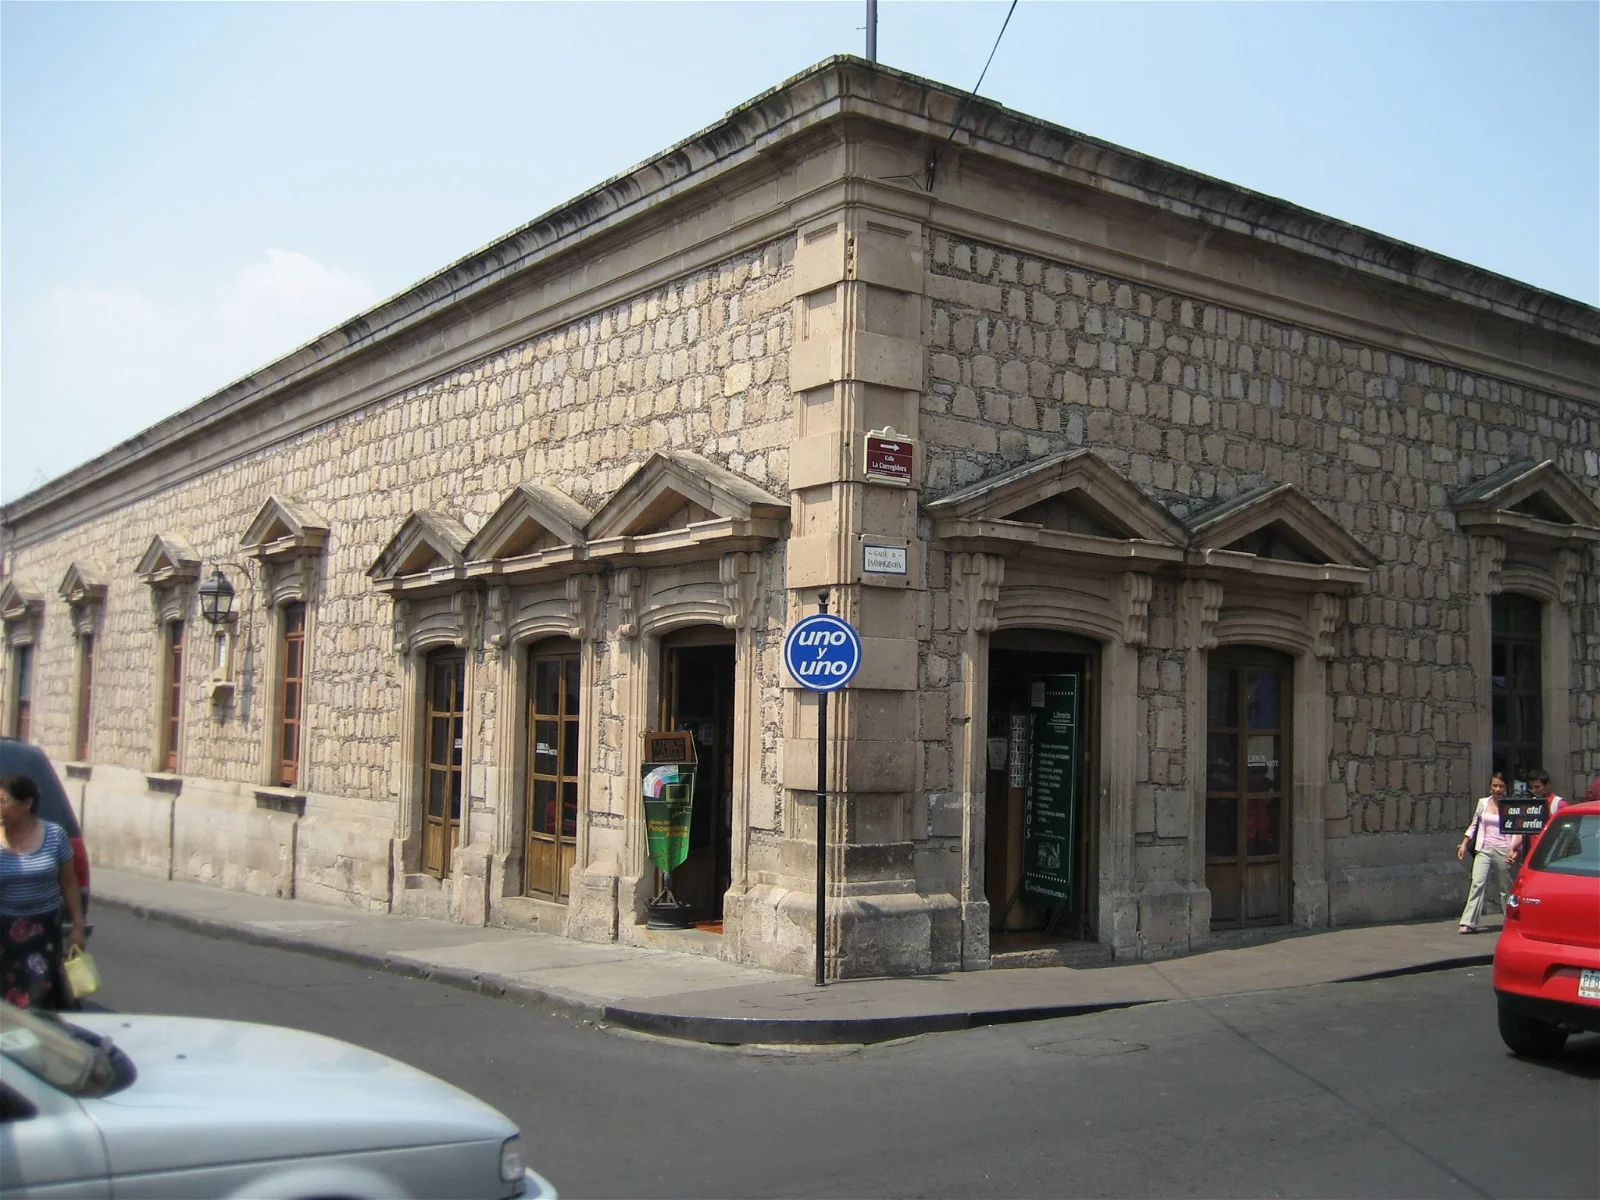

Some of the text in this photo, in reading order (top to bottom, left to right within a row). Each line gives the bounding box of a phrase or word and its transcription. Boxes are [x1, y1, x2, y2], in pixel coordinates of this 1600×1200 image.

[879, 462, 907, 472] Corregidora
[798, 630, 847, 646] uno
[816, 647, 828, 660] y
[799, 660, 848, 676] uno
[1504, 819, 1513, 829] de
